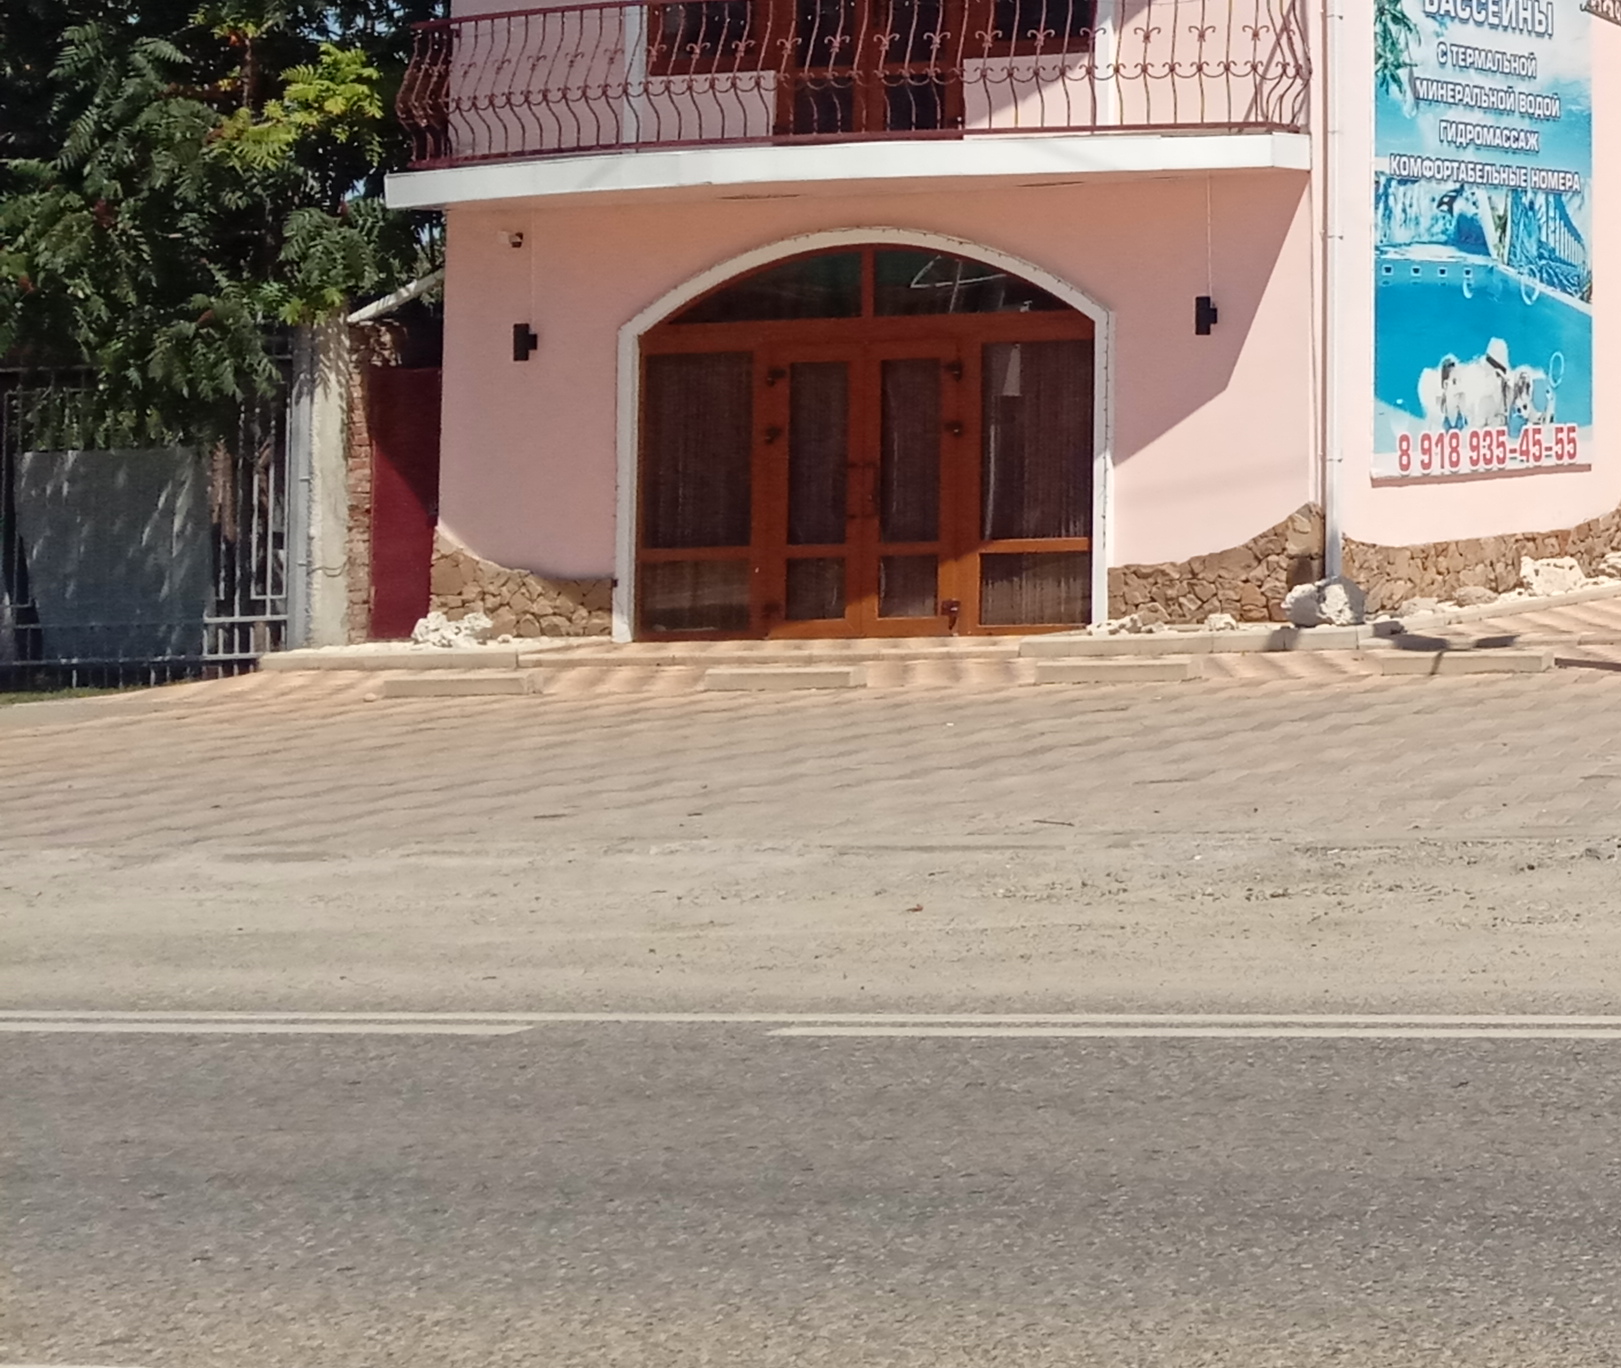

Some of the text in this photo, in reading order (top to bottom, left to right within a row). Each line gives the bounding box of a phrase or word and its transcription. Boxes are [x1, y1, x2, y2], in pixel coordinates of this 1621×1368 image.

[1437, 43, 1538, 78] С ТЕРМАЛЬНОЙ
[1415, 78, 1561, 118] МИНЕРАЛЬНОЙ ВОДОЙ
[1440, 119, 1540, 152] ГИДРОМАССАЖ
[1390, 153, 1581, 192] КОМФОРТАБЕЛЬНЫЕ НОМЕРА
[1398, 425, 1578, 472] 8 918 935-45-55
